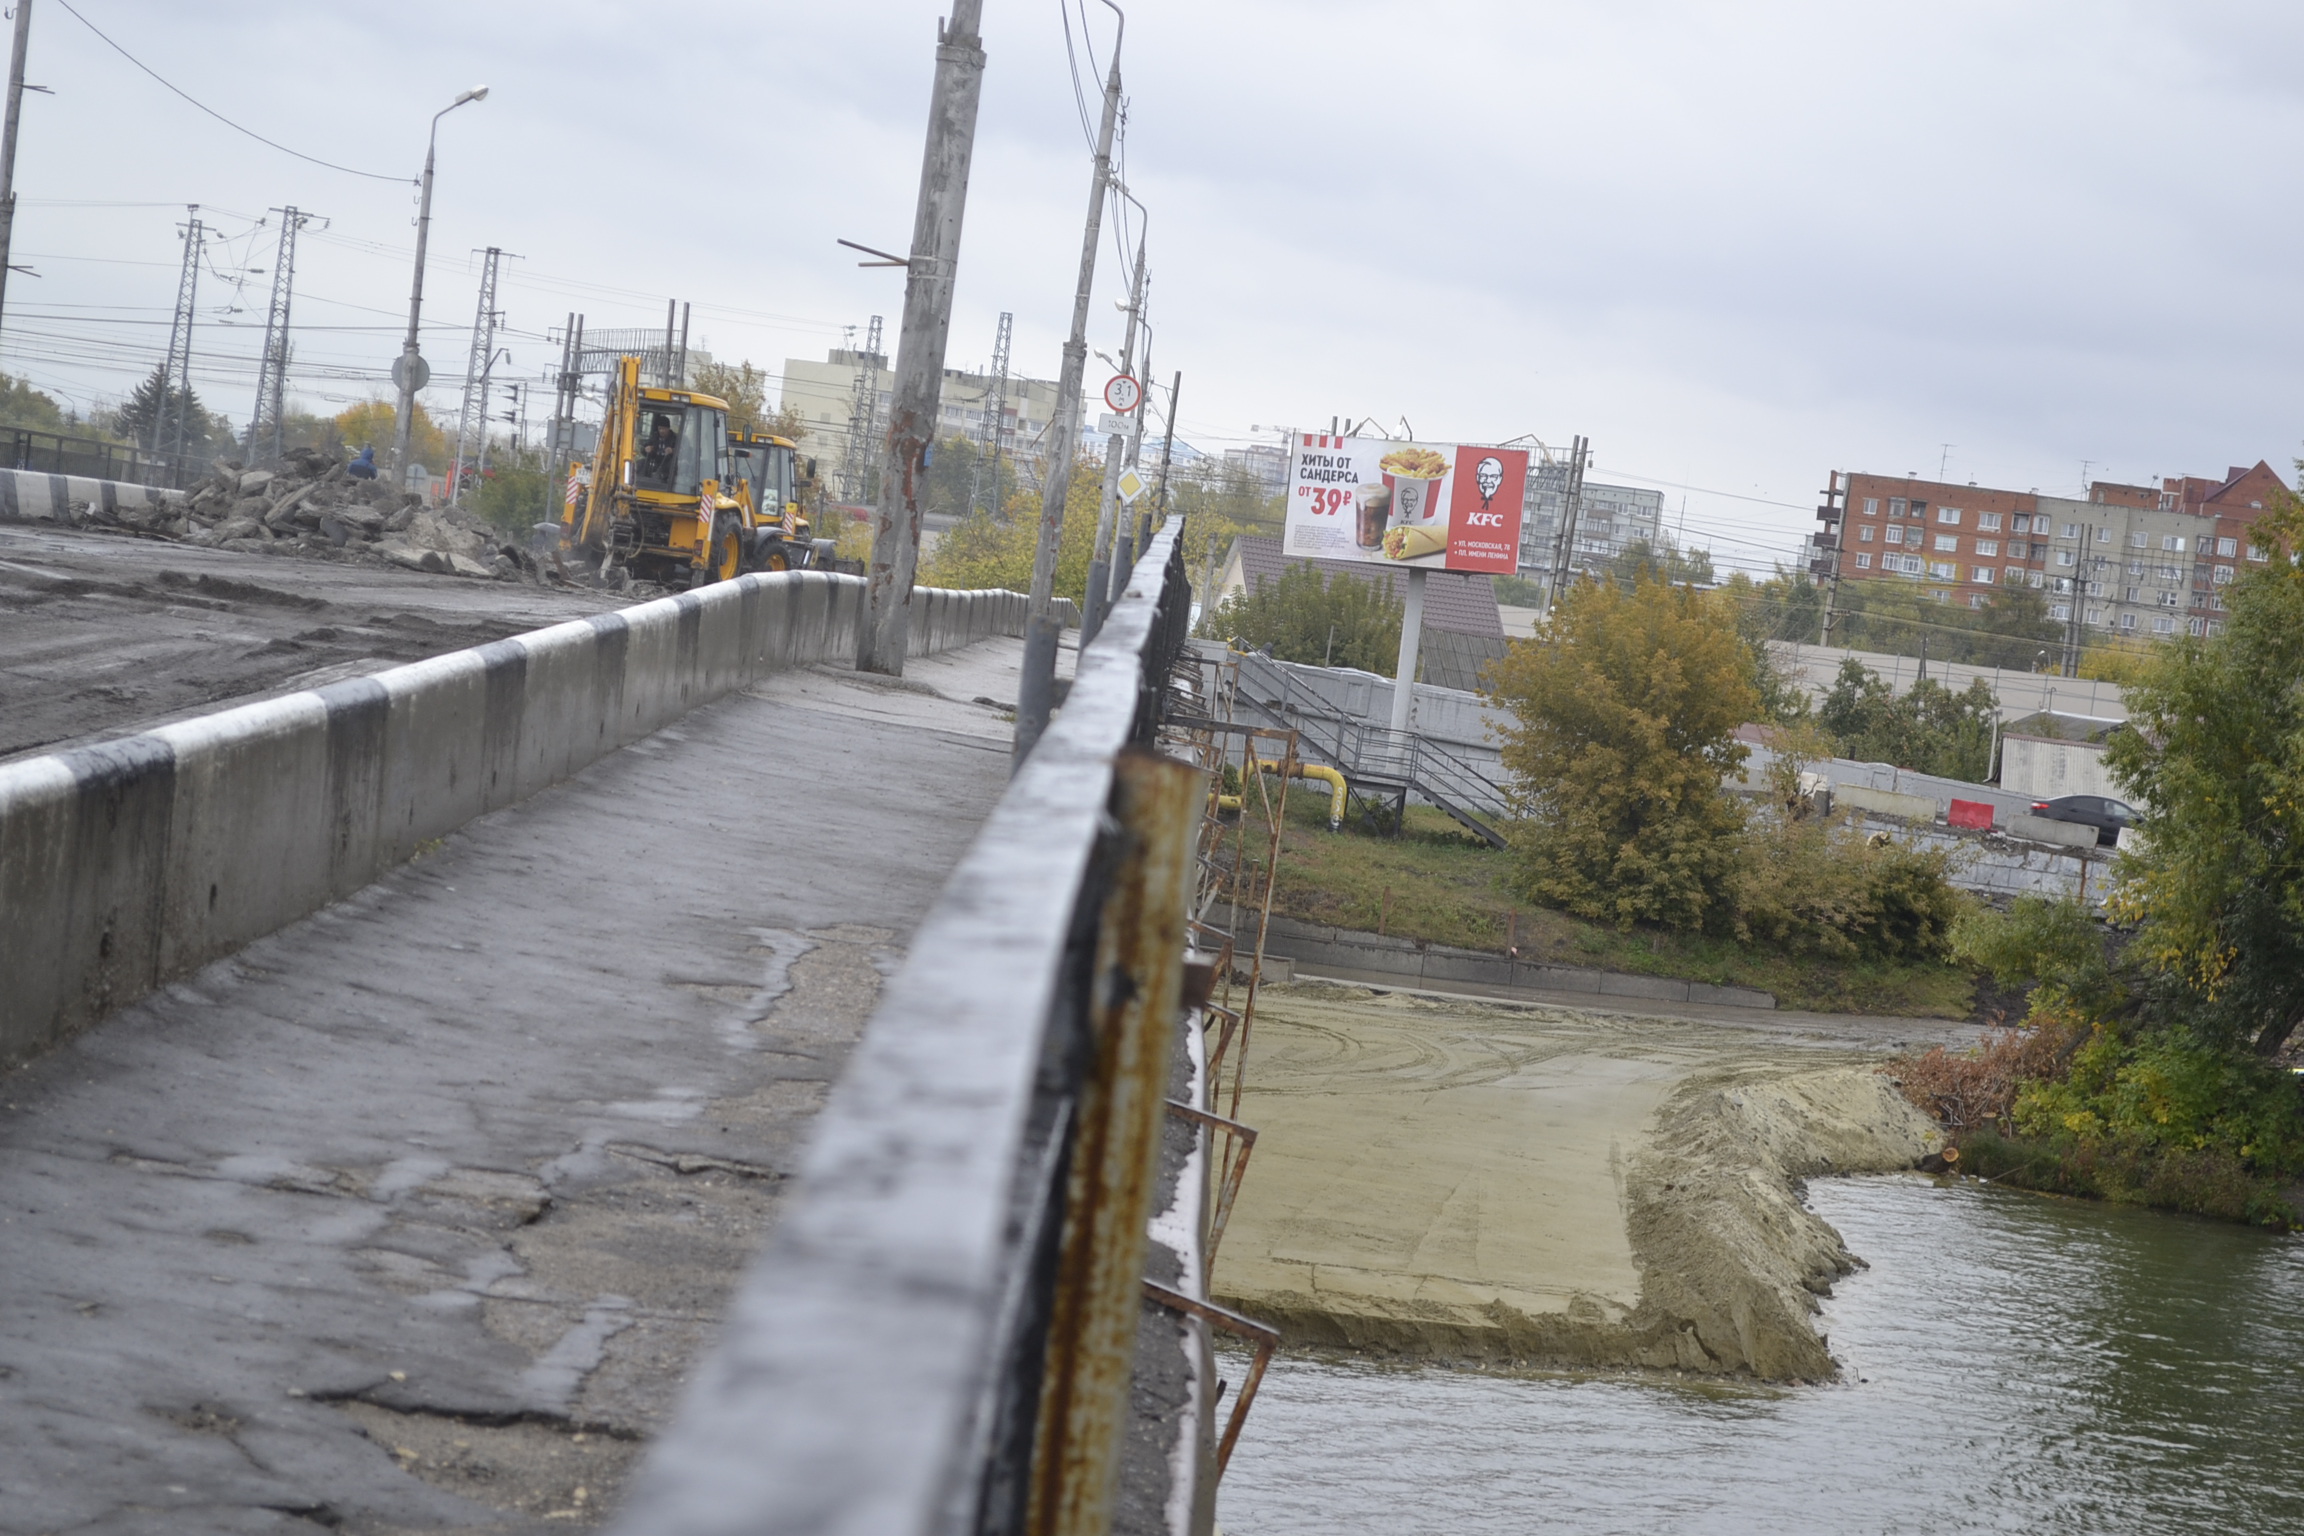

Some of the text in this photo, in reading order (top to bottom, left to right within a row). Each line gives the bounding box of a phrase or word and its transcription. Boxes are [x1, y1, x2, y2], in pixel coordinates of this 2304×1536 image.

[1301, 453, 1352, 470] ХИТЫ ОТ
[1300, 467, 1359, 484] САНДЕРСА
[1298, 485, 1311, 497] ОТ
[1466, 511, 1504, 527] KFC
[1468, 550, 1487, 558] ИМЕНИ
[1487, 551, 1509, 560] ЛЕНИНА
